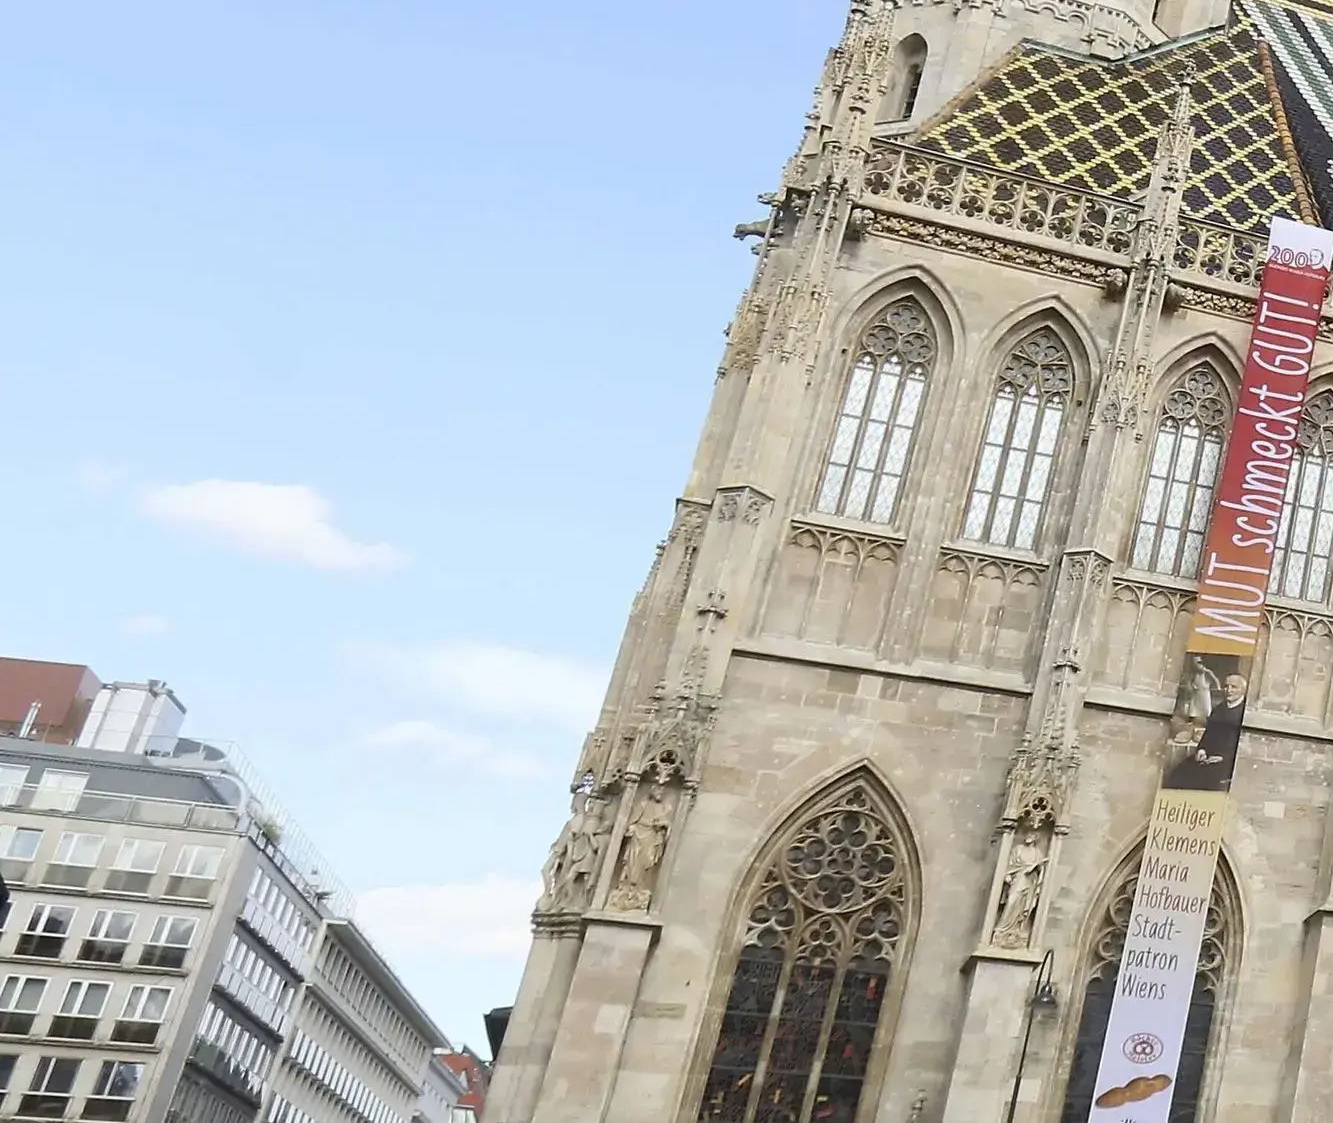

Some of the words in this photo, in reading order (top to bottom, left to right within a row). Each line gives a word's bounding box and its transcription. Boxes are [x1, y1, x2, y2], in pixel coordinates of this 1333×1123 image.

[1252, 291, 1319, 376] GUT!
[1219, 384, 1304, 554] schmeckt
[1195, 552, 1270, 644] MUT
[1156, 798, 1215, 831] Heiliger
[1150, 827, 1216, 856] Klemens
[1144, 856, 1189, 882] Maria
[1138, 884, 1207, 914] Hofbauer
[1132, 913, 1182, 941] Stadt-
[1125, 947, 1178, 972] patron
[1121, 973, 1167, 1000] Wiens
